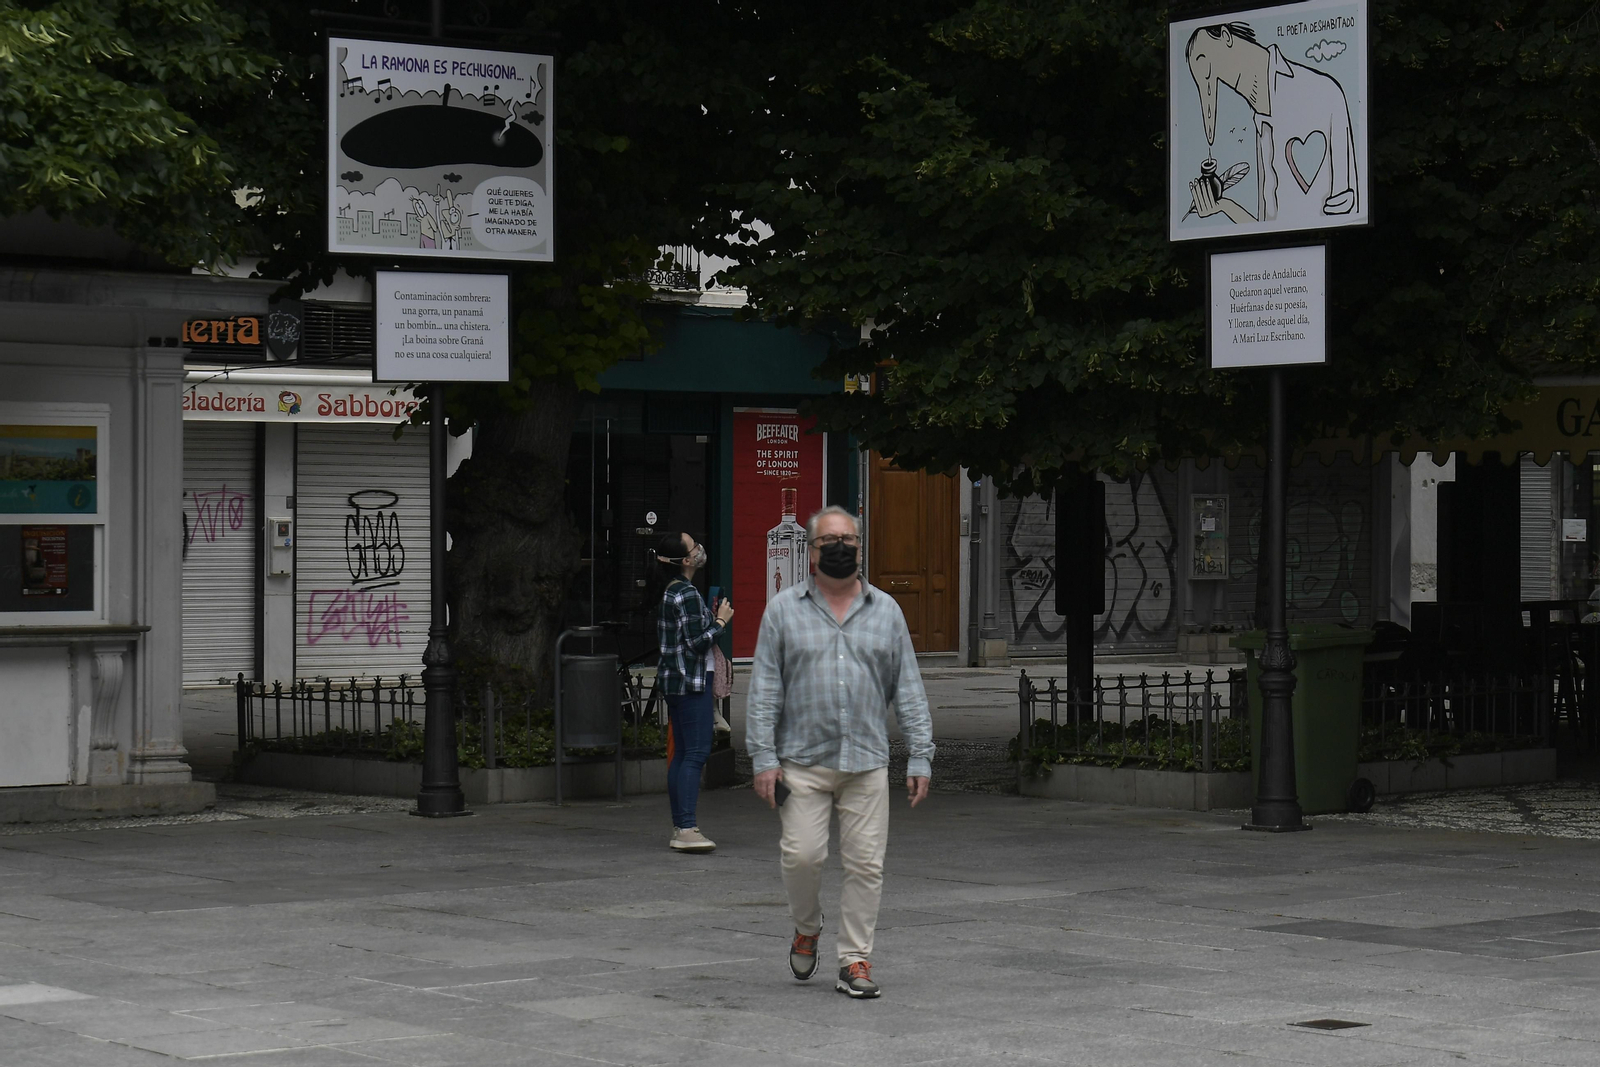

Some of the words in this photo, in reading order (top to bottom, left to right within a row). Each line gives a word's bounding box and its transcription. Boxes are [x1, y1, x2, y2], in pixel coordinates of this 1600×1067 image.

[1277, 26, 1285, 37] EL
[1286, 22, 1308, 36] POETA
[1309, 16, 1355, 32] DESHABITADO
[362, 54, 377, 69] LA
[382, 55, 430, 74] RAMONA
[434, 60, 448, 74] ES
[452, 61, 525, 81] PECHUGONA...
[486, 187, 502, 197] QUÉ
[502, 189, 534, 198] QUIERES
[488, 198, 503, 206] QUE
[504, 199, 513, 207] TE
[514, 199, 535, 208] DIGA,
[488, 207, 499, 215] ME
[499, 208, 510, 216] LA
[511, 206, 534, 217] HABÍA
[484, 217, 526, 226] IMAGINADO
[527, 218, 538, 227] DE
[485, 227, 506, 235] OTRA
[507, 228, 538, 237] MANERA
[1230, 272, 1242, 283] Las
[1243, 271, 1261, 282] letras
[1262, 269, 1271, 280] de
[1272, 267, 1307, 279] Andalucía
[394, 290, 452, 302] Contaminación
[453, 292, 491, 303] sombrera:
[1229, 286, 1263, 300] Quedaron
[1263, 284, 1282, 298] aquel
[1283, 285, 1309, 295] verano,
[402, 307, 417, 316] una
[418, 308, 441, 318] gorra,
[453, 307, 484, 318] panamá
[1230, 301, 1264, 314] Huérfanas
[1265, 300, 1274, 311] de
[1275, 303, 1283, 311] su
[1284, 299, 1308, 313] poesía,
[444, 323, 458, 331] una
[459, 321, 491, 331] chistera.
[1228, 319, 1234, 329] Y
[1234, 318, 1256, 329] lloran,
[1256, 315, 1276, 327] desde
[1276, 314, 1296, 328] aquel
[1297, 314, 1310, 325] día,
[402, 334, 414, 346] ¡La
[415, 335, 438, 345] boina
[438, 335, 460, 345] sobre
[460, 335, 484, 346] Graná
[1232, 334, 1239, 344] A
[1239, 332, 1256, 344] Mari
[1256, 332, 1270, 342] Luz
[1270, 330, 1306, 343] Escribano.
[394, 350, 405, 358] no
[406, 351, 415, 359] es
[416, 351, 431, 359] una
[432, 351, 449, 359] cosa
[450, 348, 492, 362] cualquiera!
[756, 423, 800, 443] BEEFEATER
[756, 449, 772, 459] THE
[773, 450, 800, 460] SPIRIT
[756, 460, 767, 468] OF
[768, 460, 800, 469] LONDON
[780, 469, 792, 477] 1820
